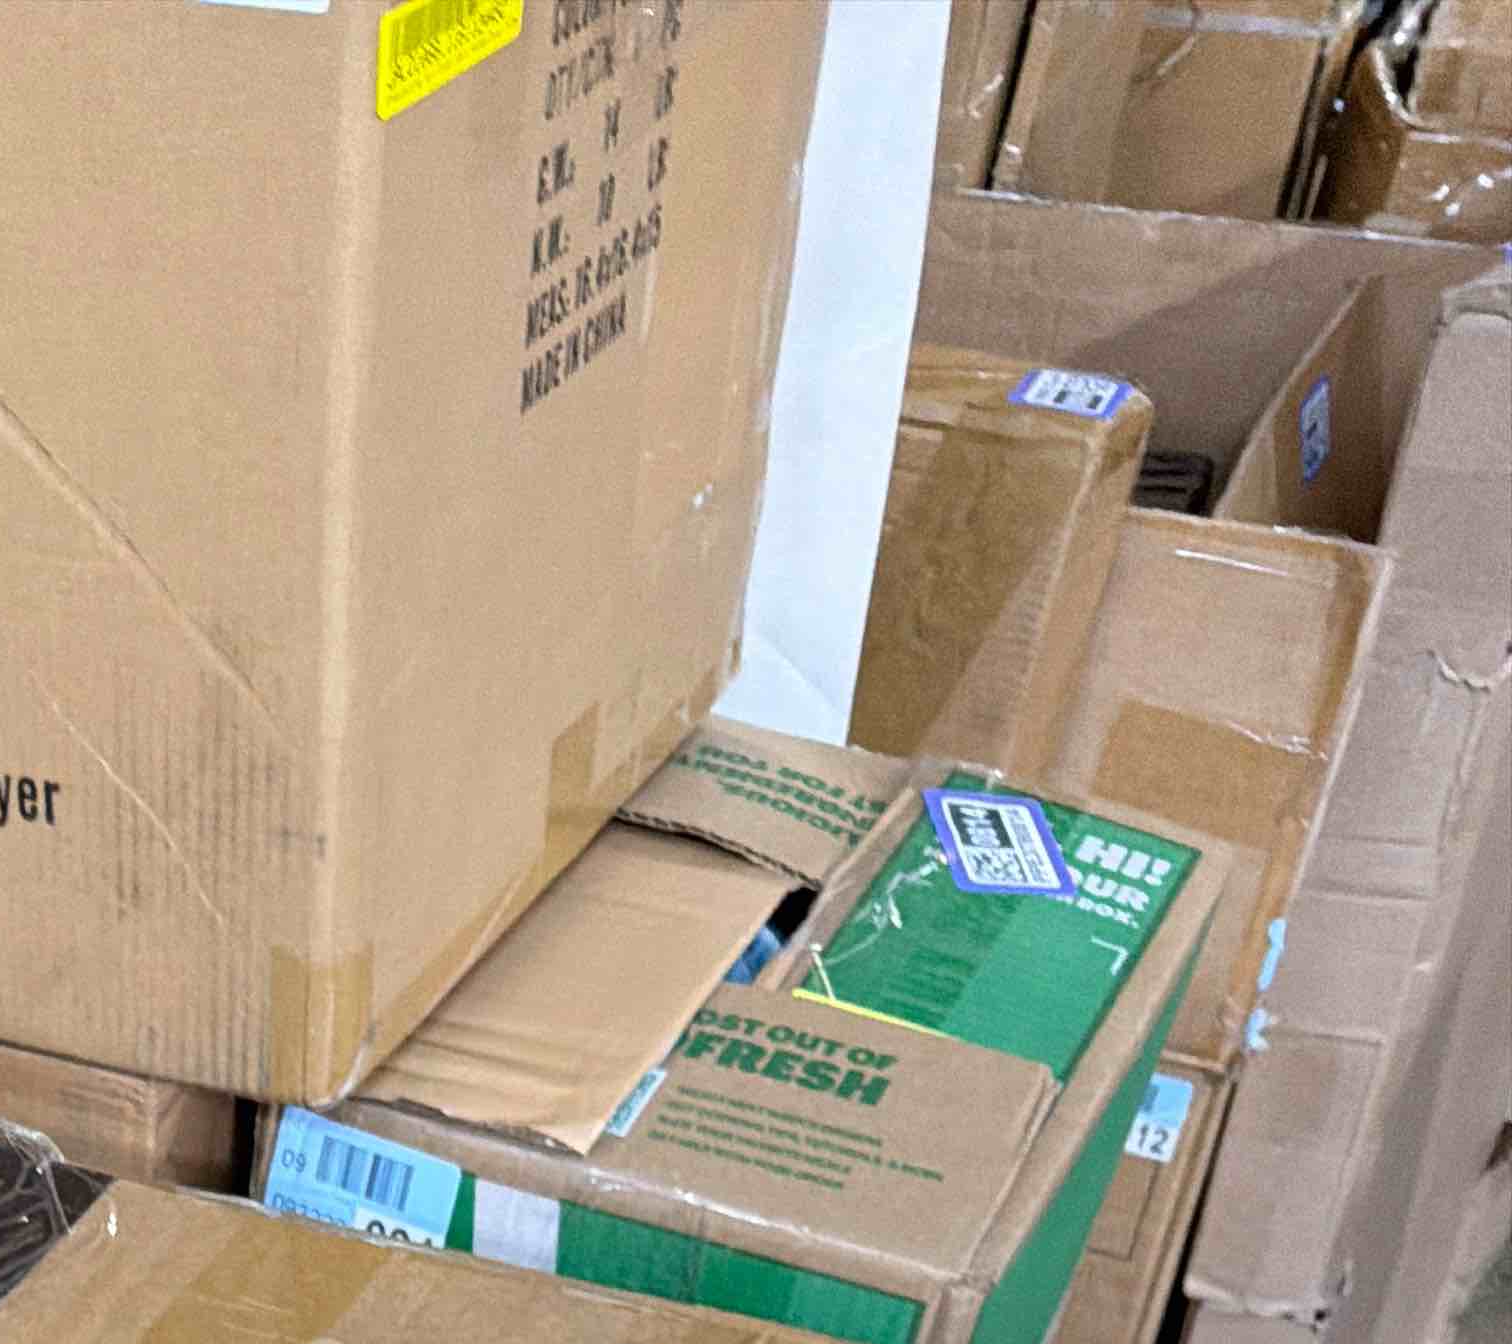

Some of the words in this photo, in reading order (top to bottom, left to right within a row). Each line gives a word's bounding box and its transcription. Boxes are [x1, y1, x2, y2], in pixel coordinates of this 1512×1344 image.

[520, 348, 560, 415] MADE
[564, 328, 580, 378] IN
[583, 292, 626, 365] CHINA
[767, 1024, 844, 1056] OUT
[846, 1046, 899, 1071] OF
